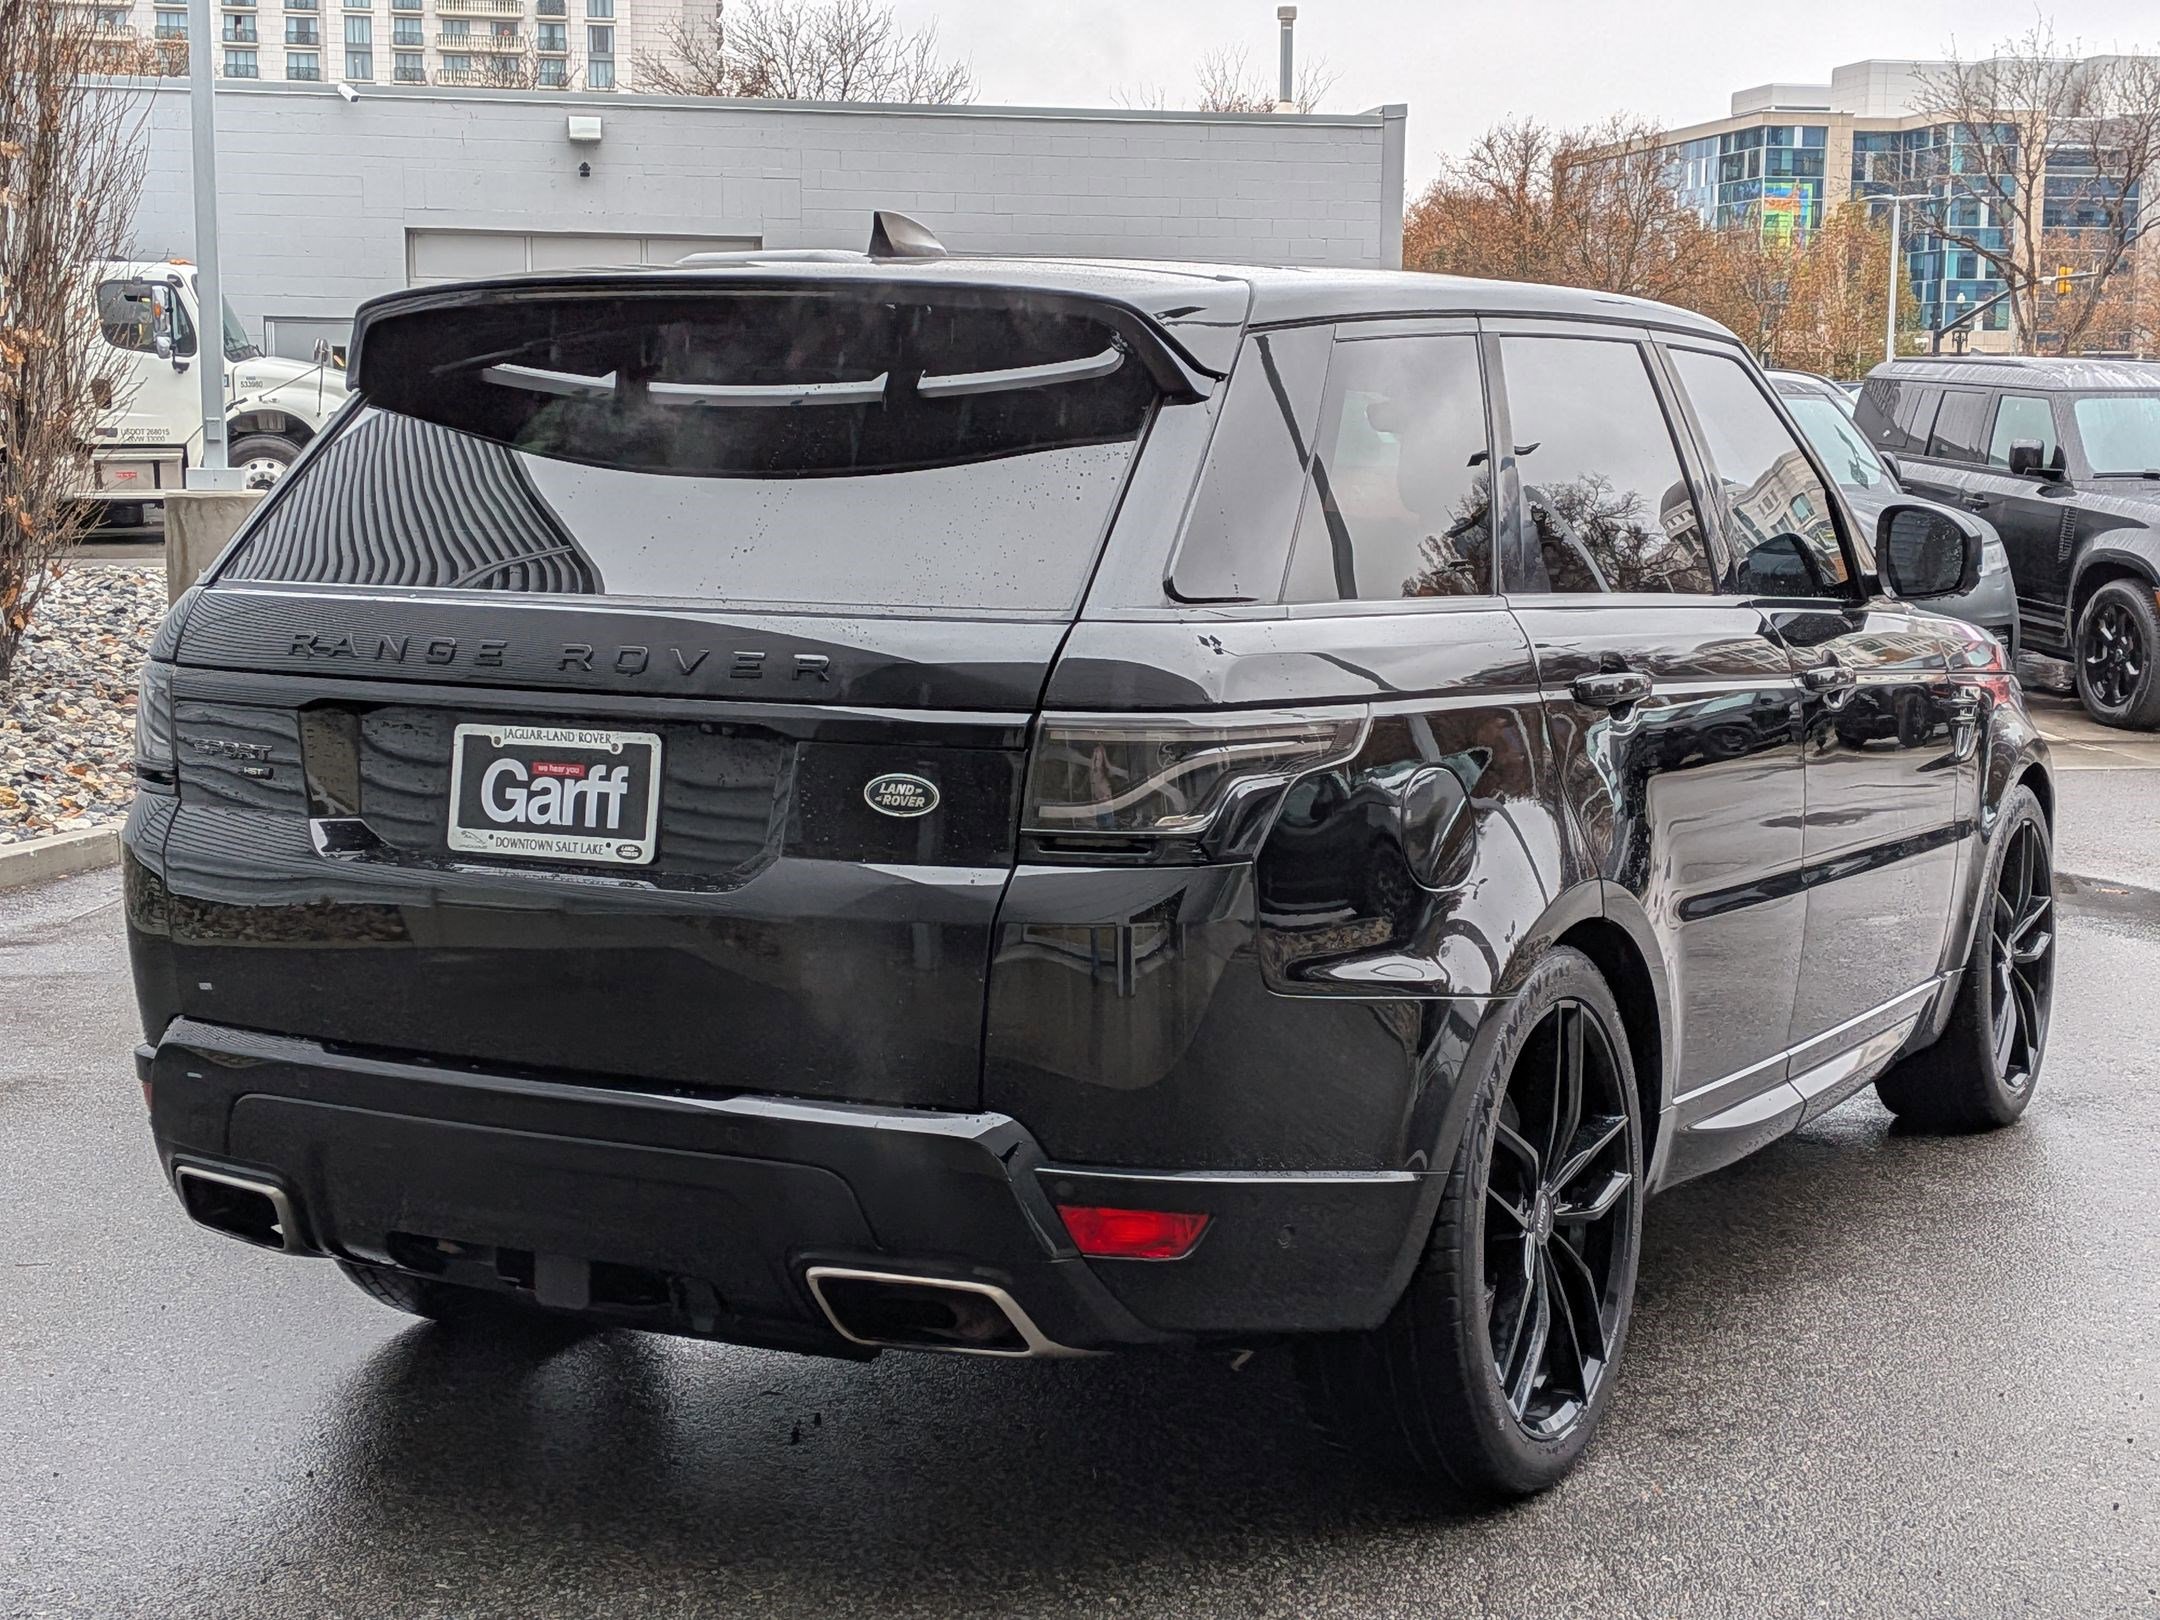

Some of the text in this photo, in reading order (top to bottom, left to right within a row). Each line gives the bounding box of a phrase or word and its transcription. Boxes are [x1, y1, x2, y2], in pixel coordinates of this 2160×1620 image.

[287, 629, 831, 683] RANGE ROVER
[504, 727, 613, 744] JAGUAR-LAND ROVER
[243, 767, 264, 776] HST
[549, 764, 565, 773] hear
[566, 766, 580, 775] you
[481, 758, 629, 829] Garff
[879, 783, 915, 796] LAND
[881, 794, 925, 807] ROVER
[495, 836, 604, 855] DOWNTOWN SALT LAKE
